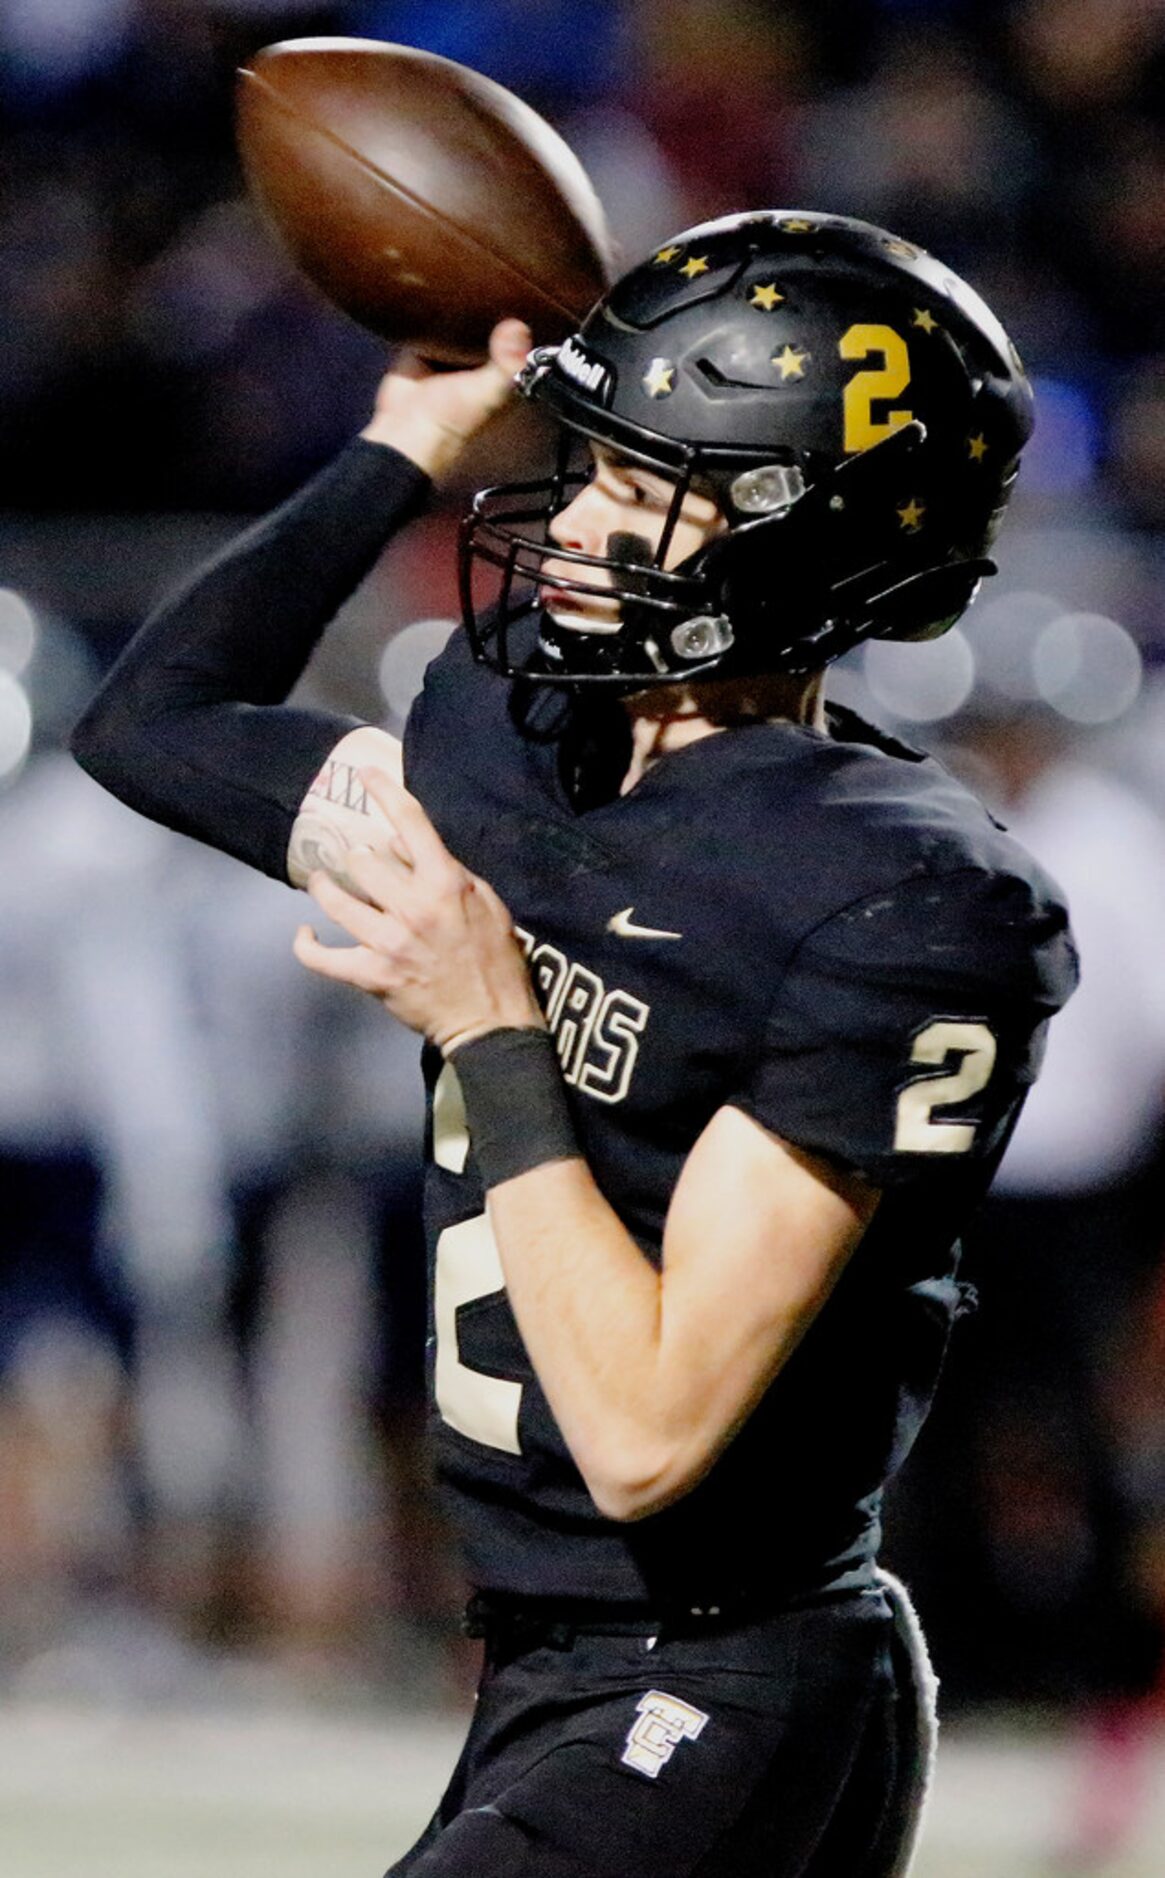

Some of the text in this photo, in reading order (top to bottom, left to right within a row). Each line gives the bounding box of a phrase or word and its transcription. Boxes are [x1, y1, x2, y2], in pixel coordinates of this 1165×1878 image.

[838, 323, 913, 452] 2
[514, 923, 650, 1104] ARS
[894, 1020, 997, 1153] 2
